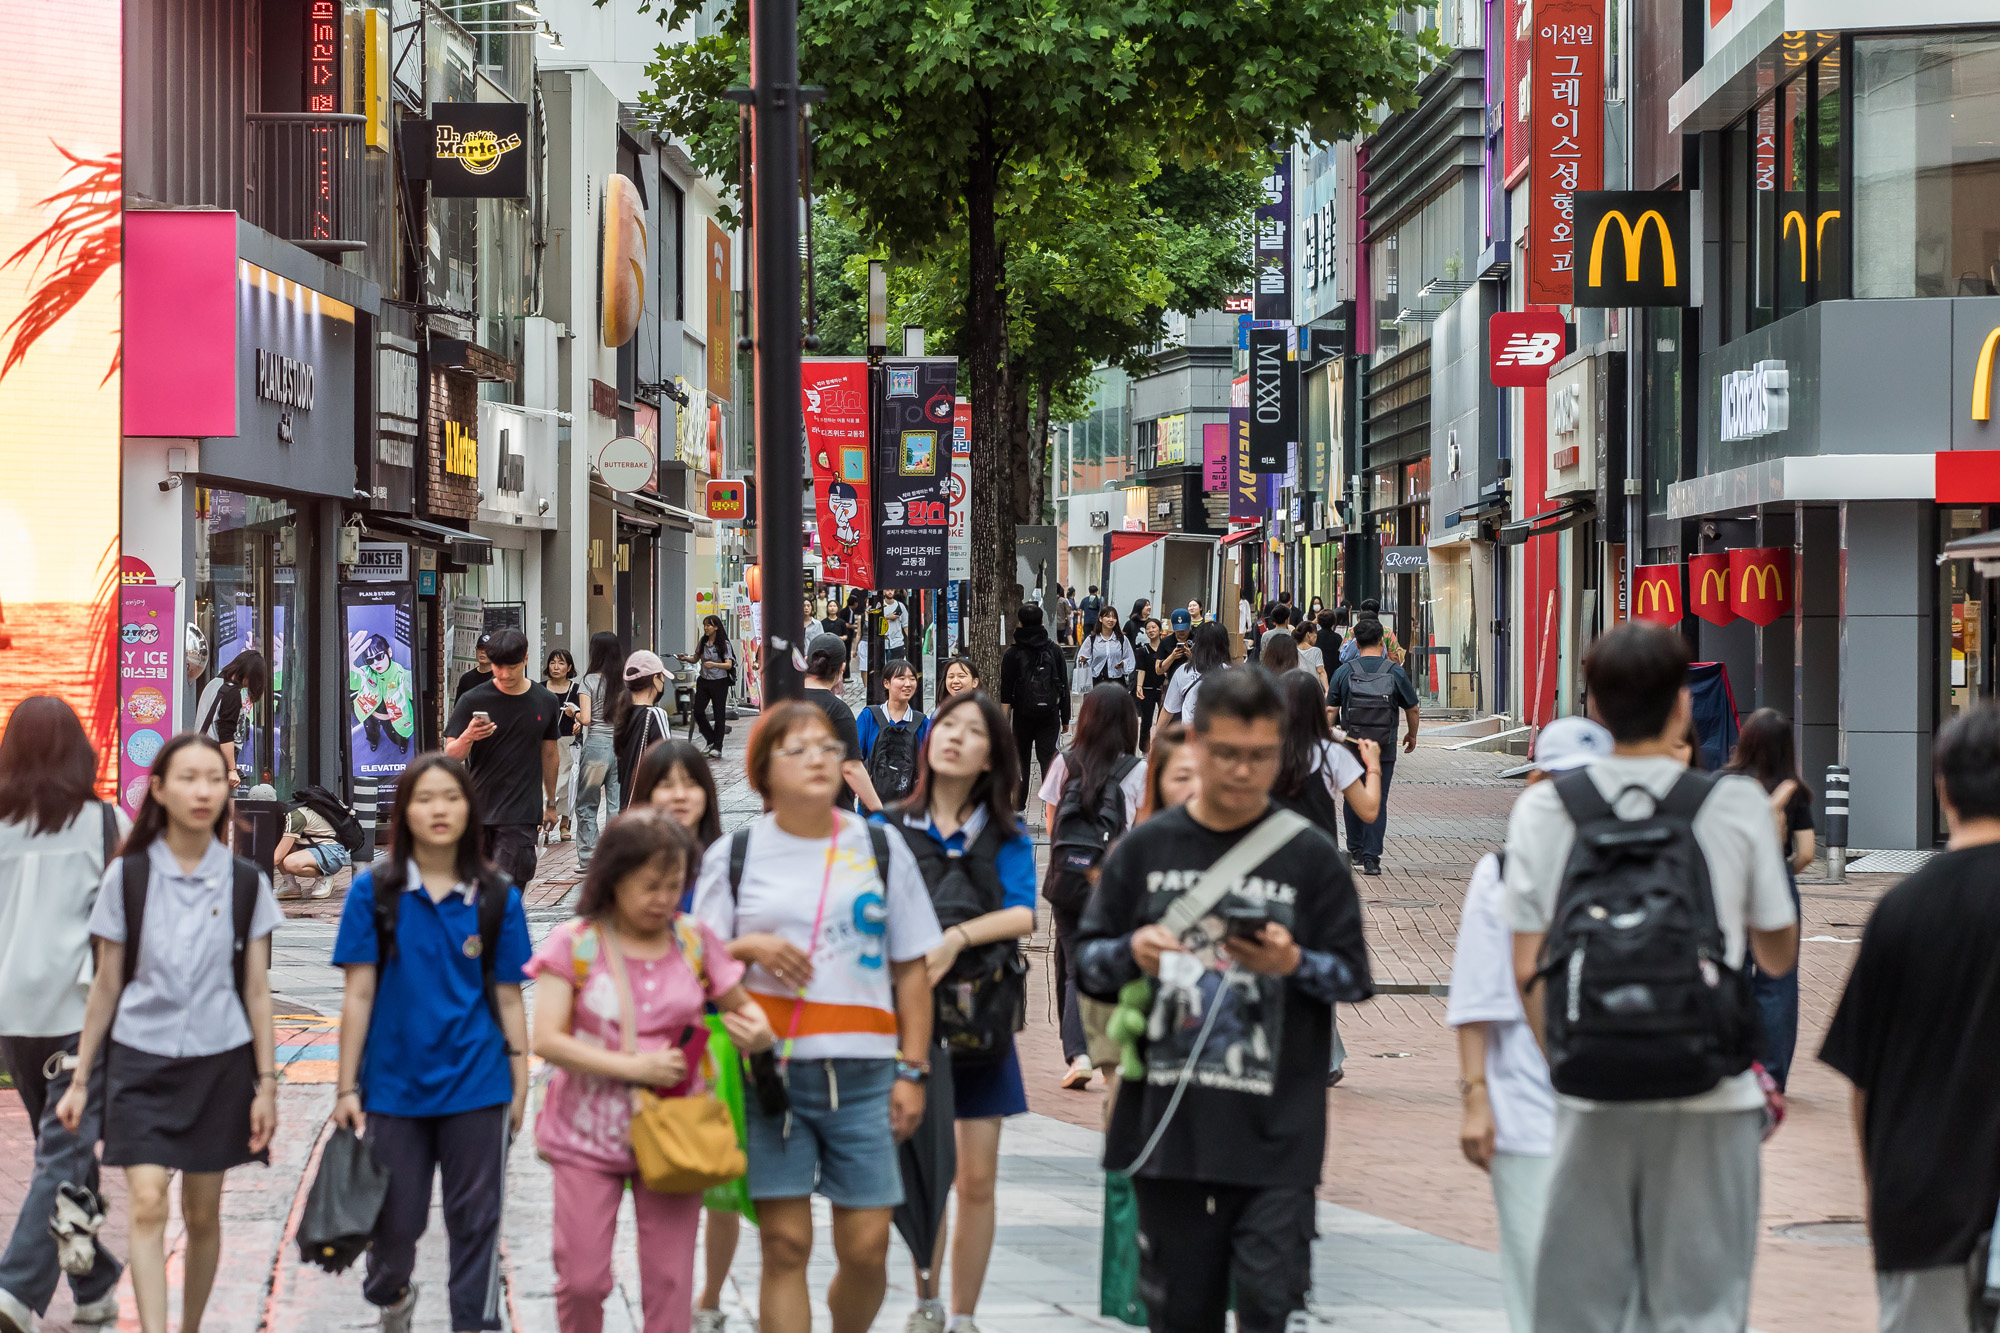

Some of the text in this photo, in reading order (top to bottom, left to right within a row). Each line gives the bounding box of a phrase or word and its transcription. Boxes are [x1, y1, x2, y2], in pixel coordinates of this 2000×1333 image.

[1541, 24, 1593, 45] 이신일
[437, 125, 461, 142] Dr.
[437, 133, 521, 158] Martens
[1256, 343, 1281, 424] MIXXO
[847, 430, 865, 438] 교동점
[604, 461, 648, 469] BUTTERBAKE
[1261, 456, 1276, 465] 미쏘
[881, 500, 948, 526] 호캉스
[886, 546, 942, 556] 라이크디즈위드
[359, 552, 402, 565] ONSTER
[901, 557, 926, 567] 교동점
[1385, 552, 1426, 567] Roem
[121, 571, 147, 585] LLY
[143, 651, 168, 665] ICE
[360, 763, 407, 773] ELEVATOR
